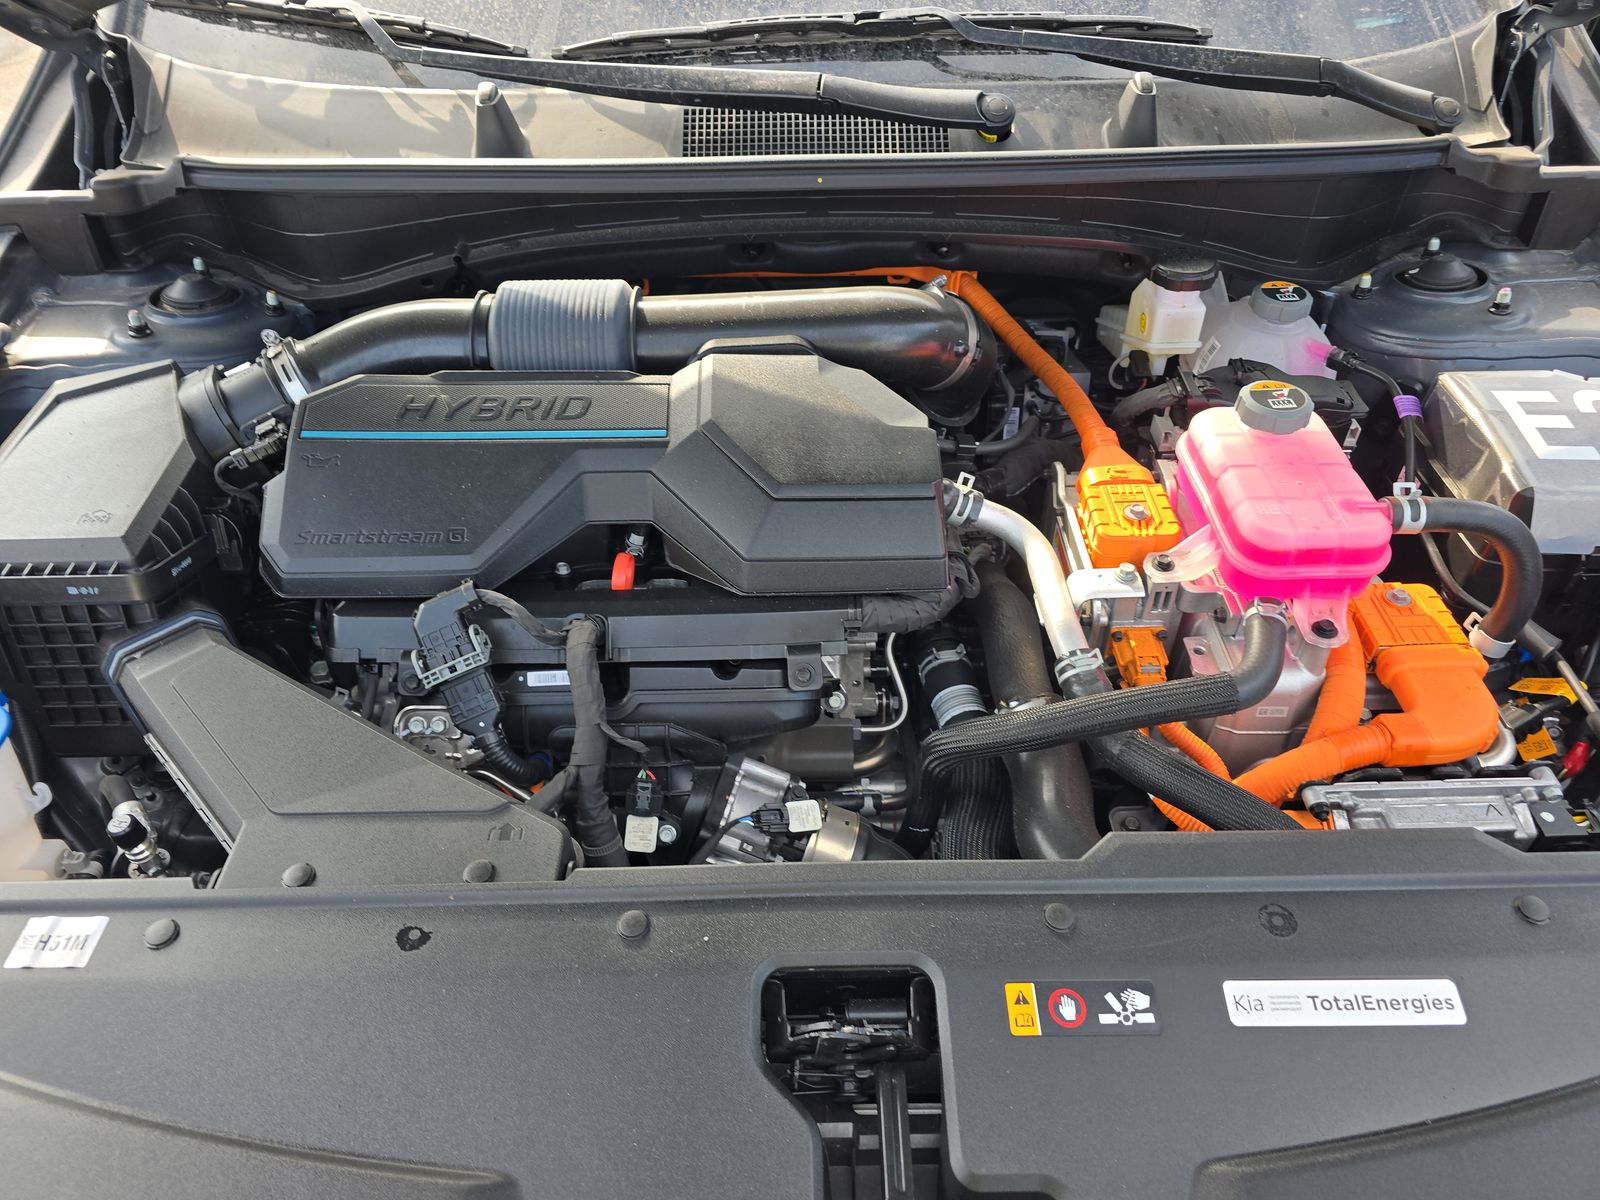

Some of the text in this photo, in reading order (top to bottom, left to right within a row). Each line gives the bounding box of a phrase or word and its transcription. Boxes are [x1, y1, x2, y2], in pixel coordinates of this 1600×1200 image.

[394, 394, 592, 421] HYBRID
[296, 529, 443, 545] Smartstream
[1233, 994, 1264, 1014] Kia
[1306, 994, 1455, 1014] TotalEnergies
